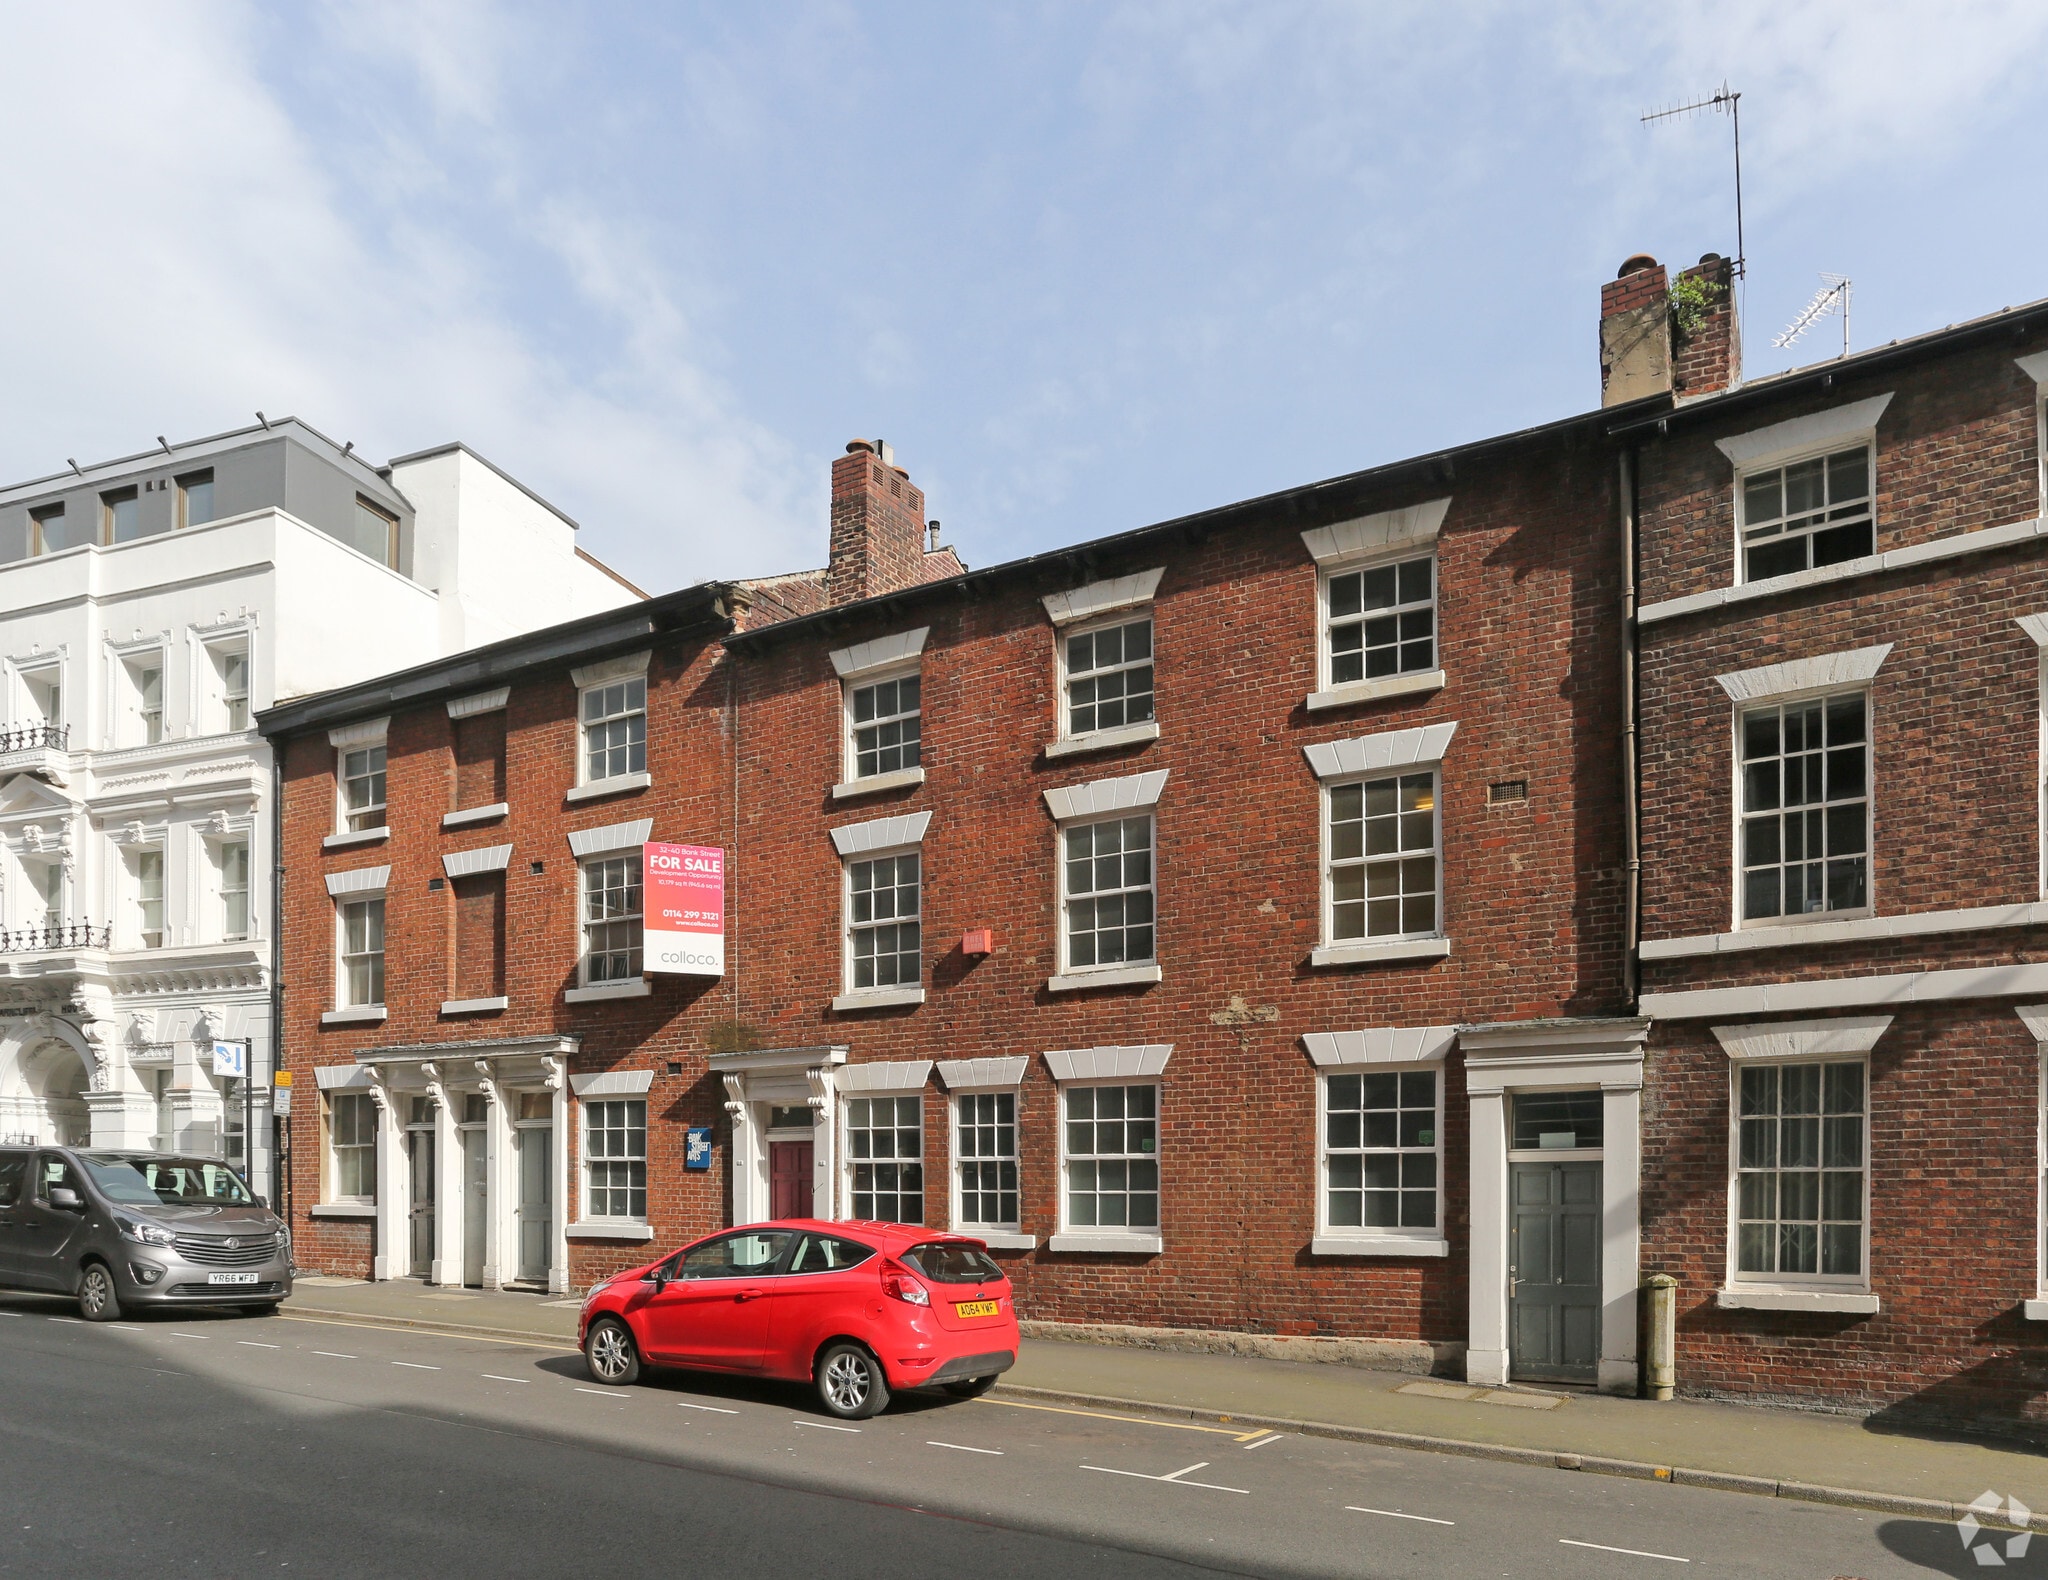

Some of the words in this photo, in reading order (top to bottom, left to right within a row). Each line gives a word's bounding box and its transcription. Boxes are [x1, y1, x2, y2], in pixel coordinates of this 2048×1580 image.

[682, 848, 698, 856] Bank
[700, 850, 720, 858] Street
[650, 855, 680, 869] FOR
[684, 858, 721, 873] SALE
[650, 869, 688, 877] Development
[688, 871, 722, 880] Opportunity
[663, 909, 682, 918] 0114
[684, 910, 700, 919] 299
[702, 912, 719, 921] 3121
[691, 1141, 711, 1152] STREET
[687, 1150, 701, 1162] ARTS
[213, 1274, 237, 1283] YR66
[238, 1274, 255, 1283] WFD
